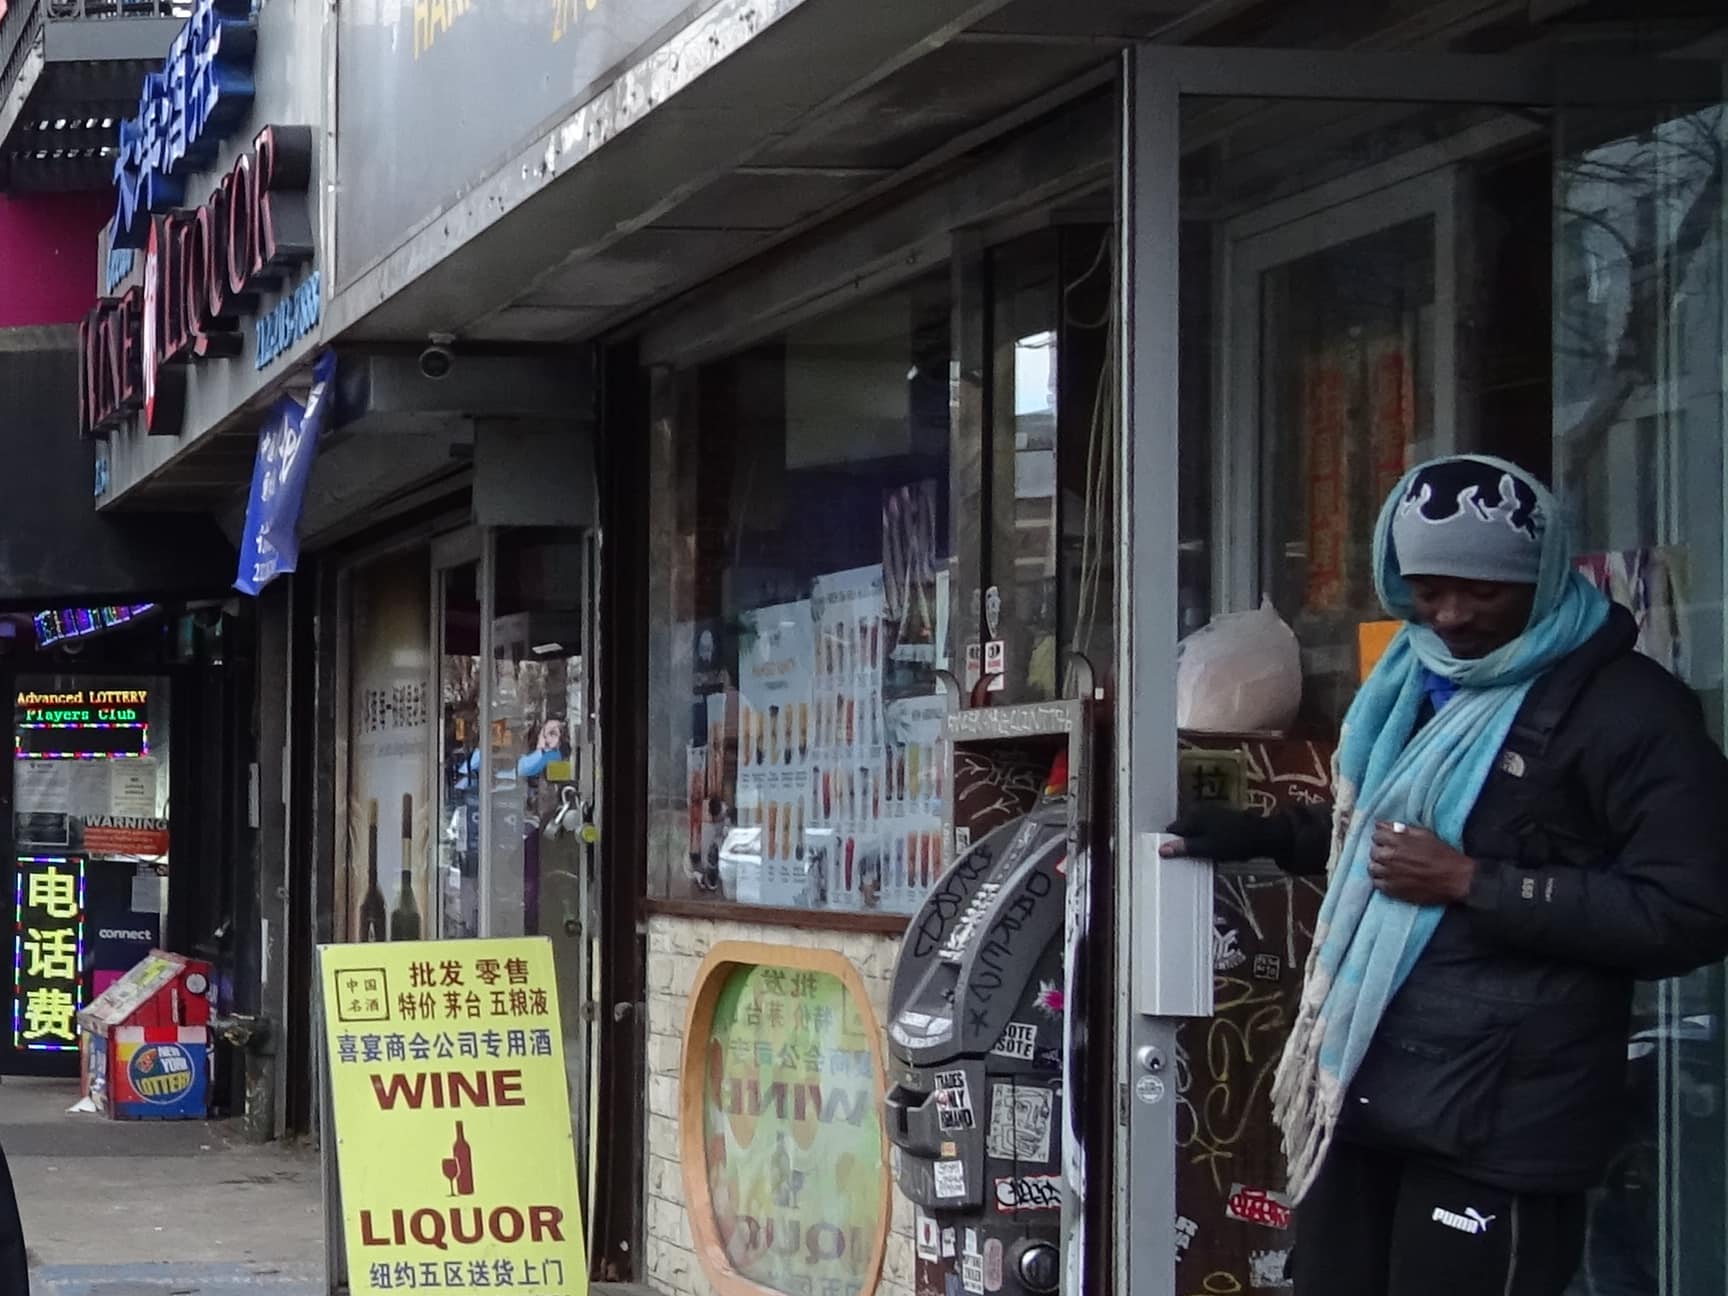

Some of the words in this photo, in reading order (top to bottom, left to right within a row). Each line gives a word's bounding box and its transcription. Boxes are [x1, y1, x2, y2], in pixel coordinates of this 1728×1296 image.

[17, 691, 84, 704] Advanced
[89, 690, 148, 704] LOTTERY
[26, 709, 89, 723] Players
[98, 708, 137, 721] Club
[86, 816, 170, 831] WARNING
[98, 928, 153, 941] connect
[22, 865, 78, 1041] 电话费
[345, 976, 379, 995] 中国
[408, 959, 465, 989] 批发
[474, 956, 531, 986] 零售
[397, 992, 437, 1021] 特价
[444, 990, 483, 1020] 茅台
[489, 986, 551, 1019] 五粮液
[336, 1027, 553, 1064] 喜宴商会公司专用酒
[369, 1068, 526, 1111] WINE
[359, 1204, 565, 1251] LIQUOR
[1431, 1206, 1479, 1235] PUMA
[368, 1258, 565, 1289] 纽约五区送货上门
